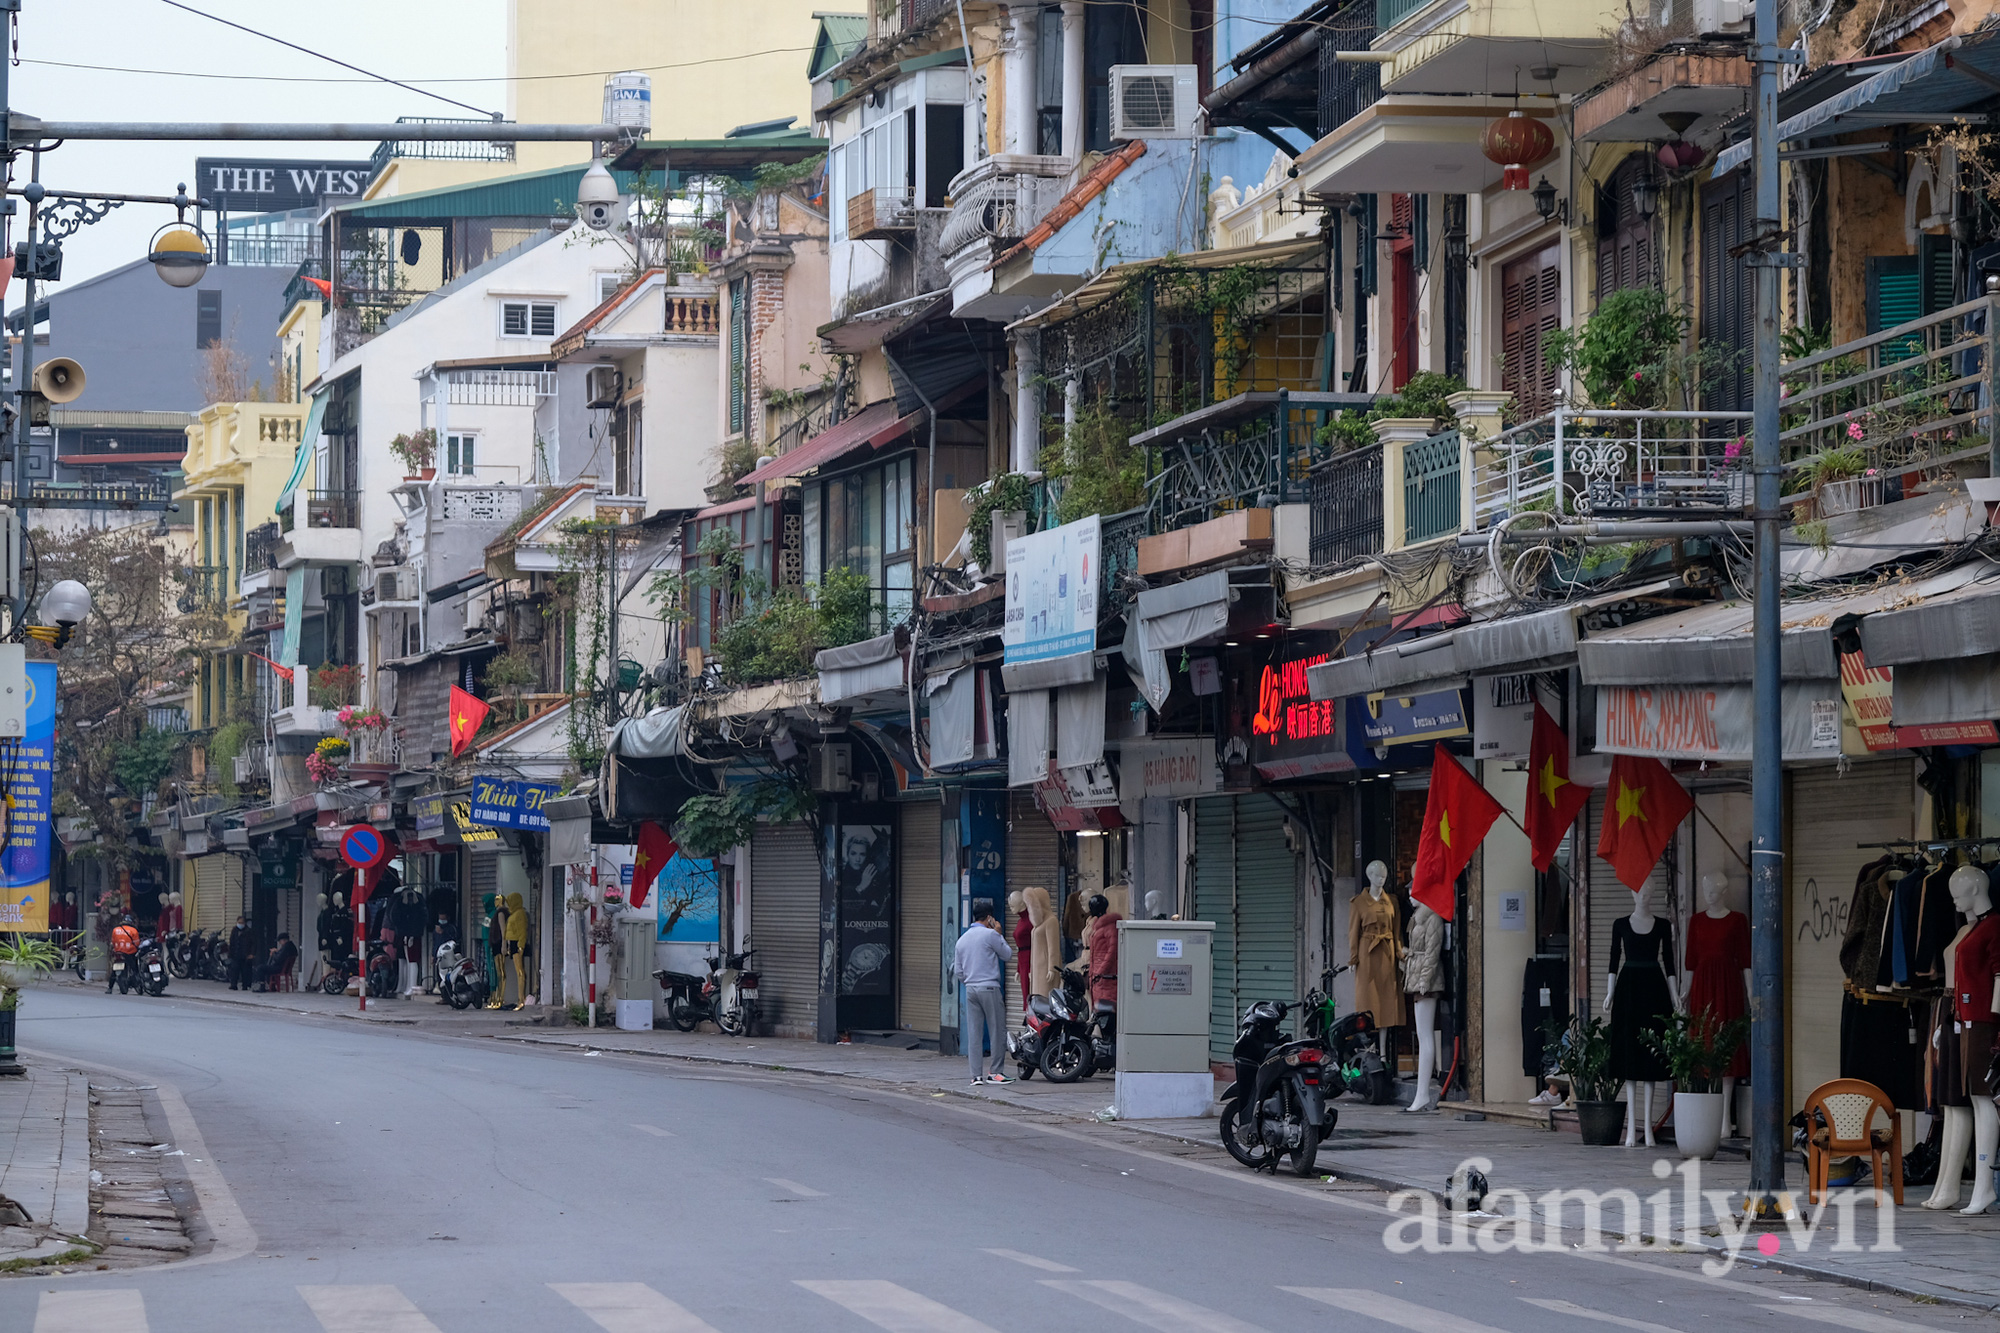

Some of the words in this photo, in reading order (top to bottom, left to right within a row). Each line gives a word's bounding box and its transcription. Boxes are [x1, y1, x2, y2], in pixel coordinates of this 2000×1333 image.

[210, 167, 275, 193] THE
[1281, 657, 1310, 698] HONG
[1154, 750, 1178, 785] HÀNG
[1179, 746, 1197, 783] ĐÀO
[477, 782, 518, 808] Hiền
[975, 850, 1002, 870] 79
[844, 920, 889, 928] LONGINES
